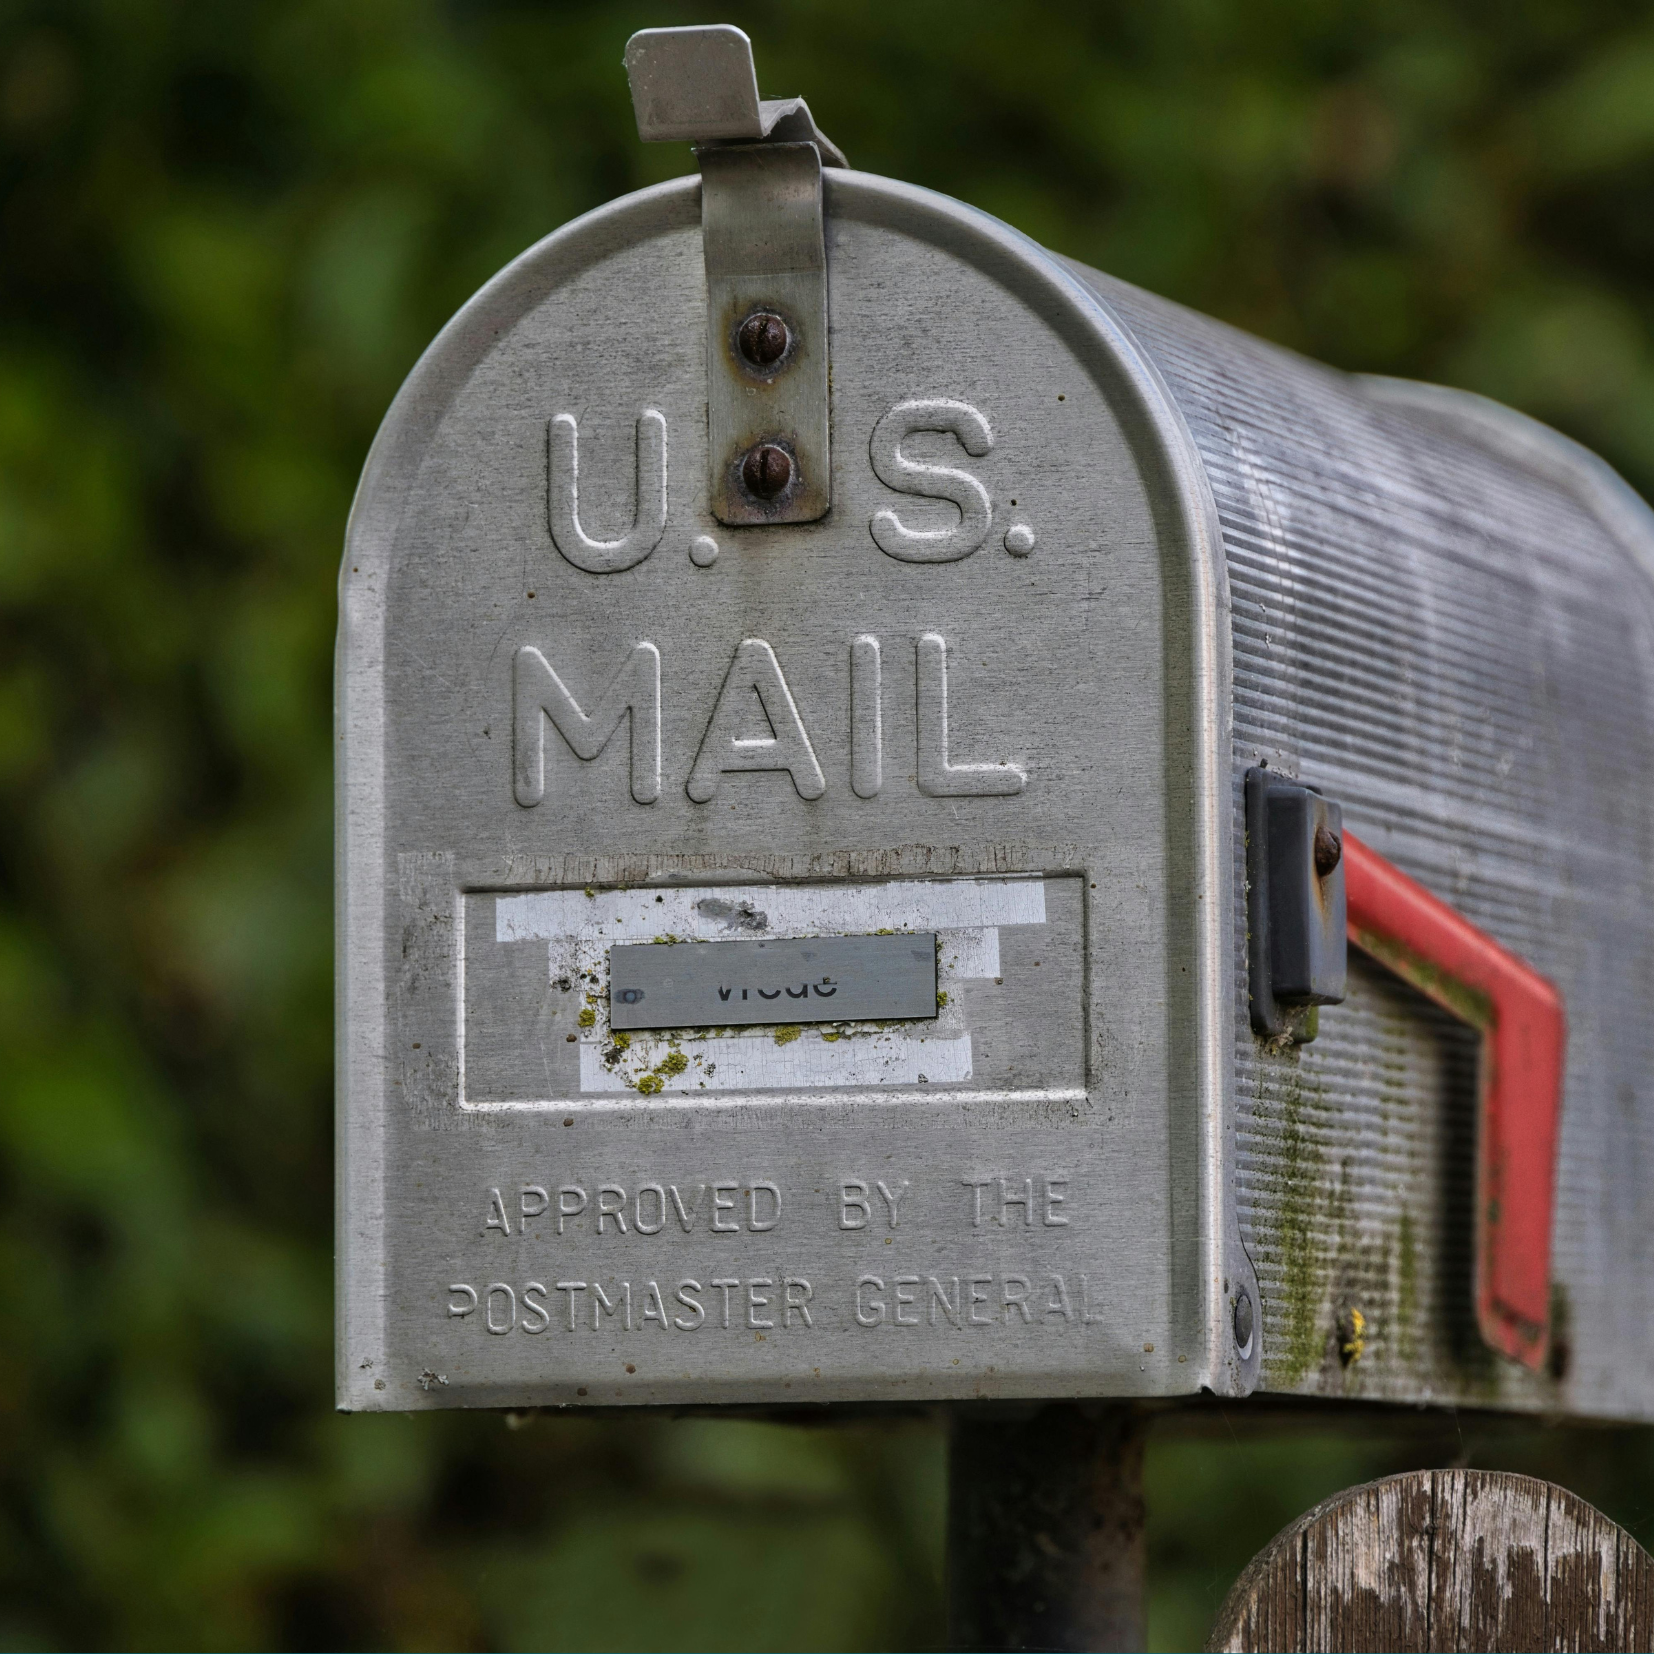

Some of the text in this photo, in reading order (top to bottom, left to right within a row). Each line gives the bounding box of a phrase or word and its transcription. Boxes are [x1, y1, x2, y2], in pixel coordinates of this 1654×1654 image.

[545, 398, 1037, 574] U. S.
[512, 632, 1029, 808] MAIL
[479, 1177, 1070, 1237] APPROVED BY THE
[447, 1274, 1103, 1336] POSTMASTER GENERAL
